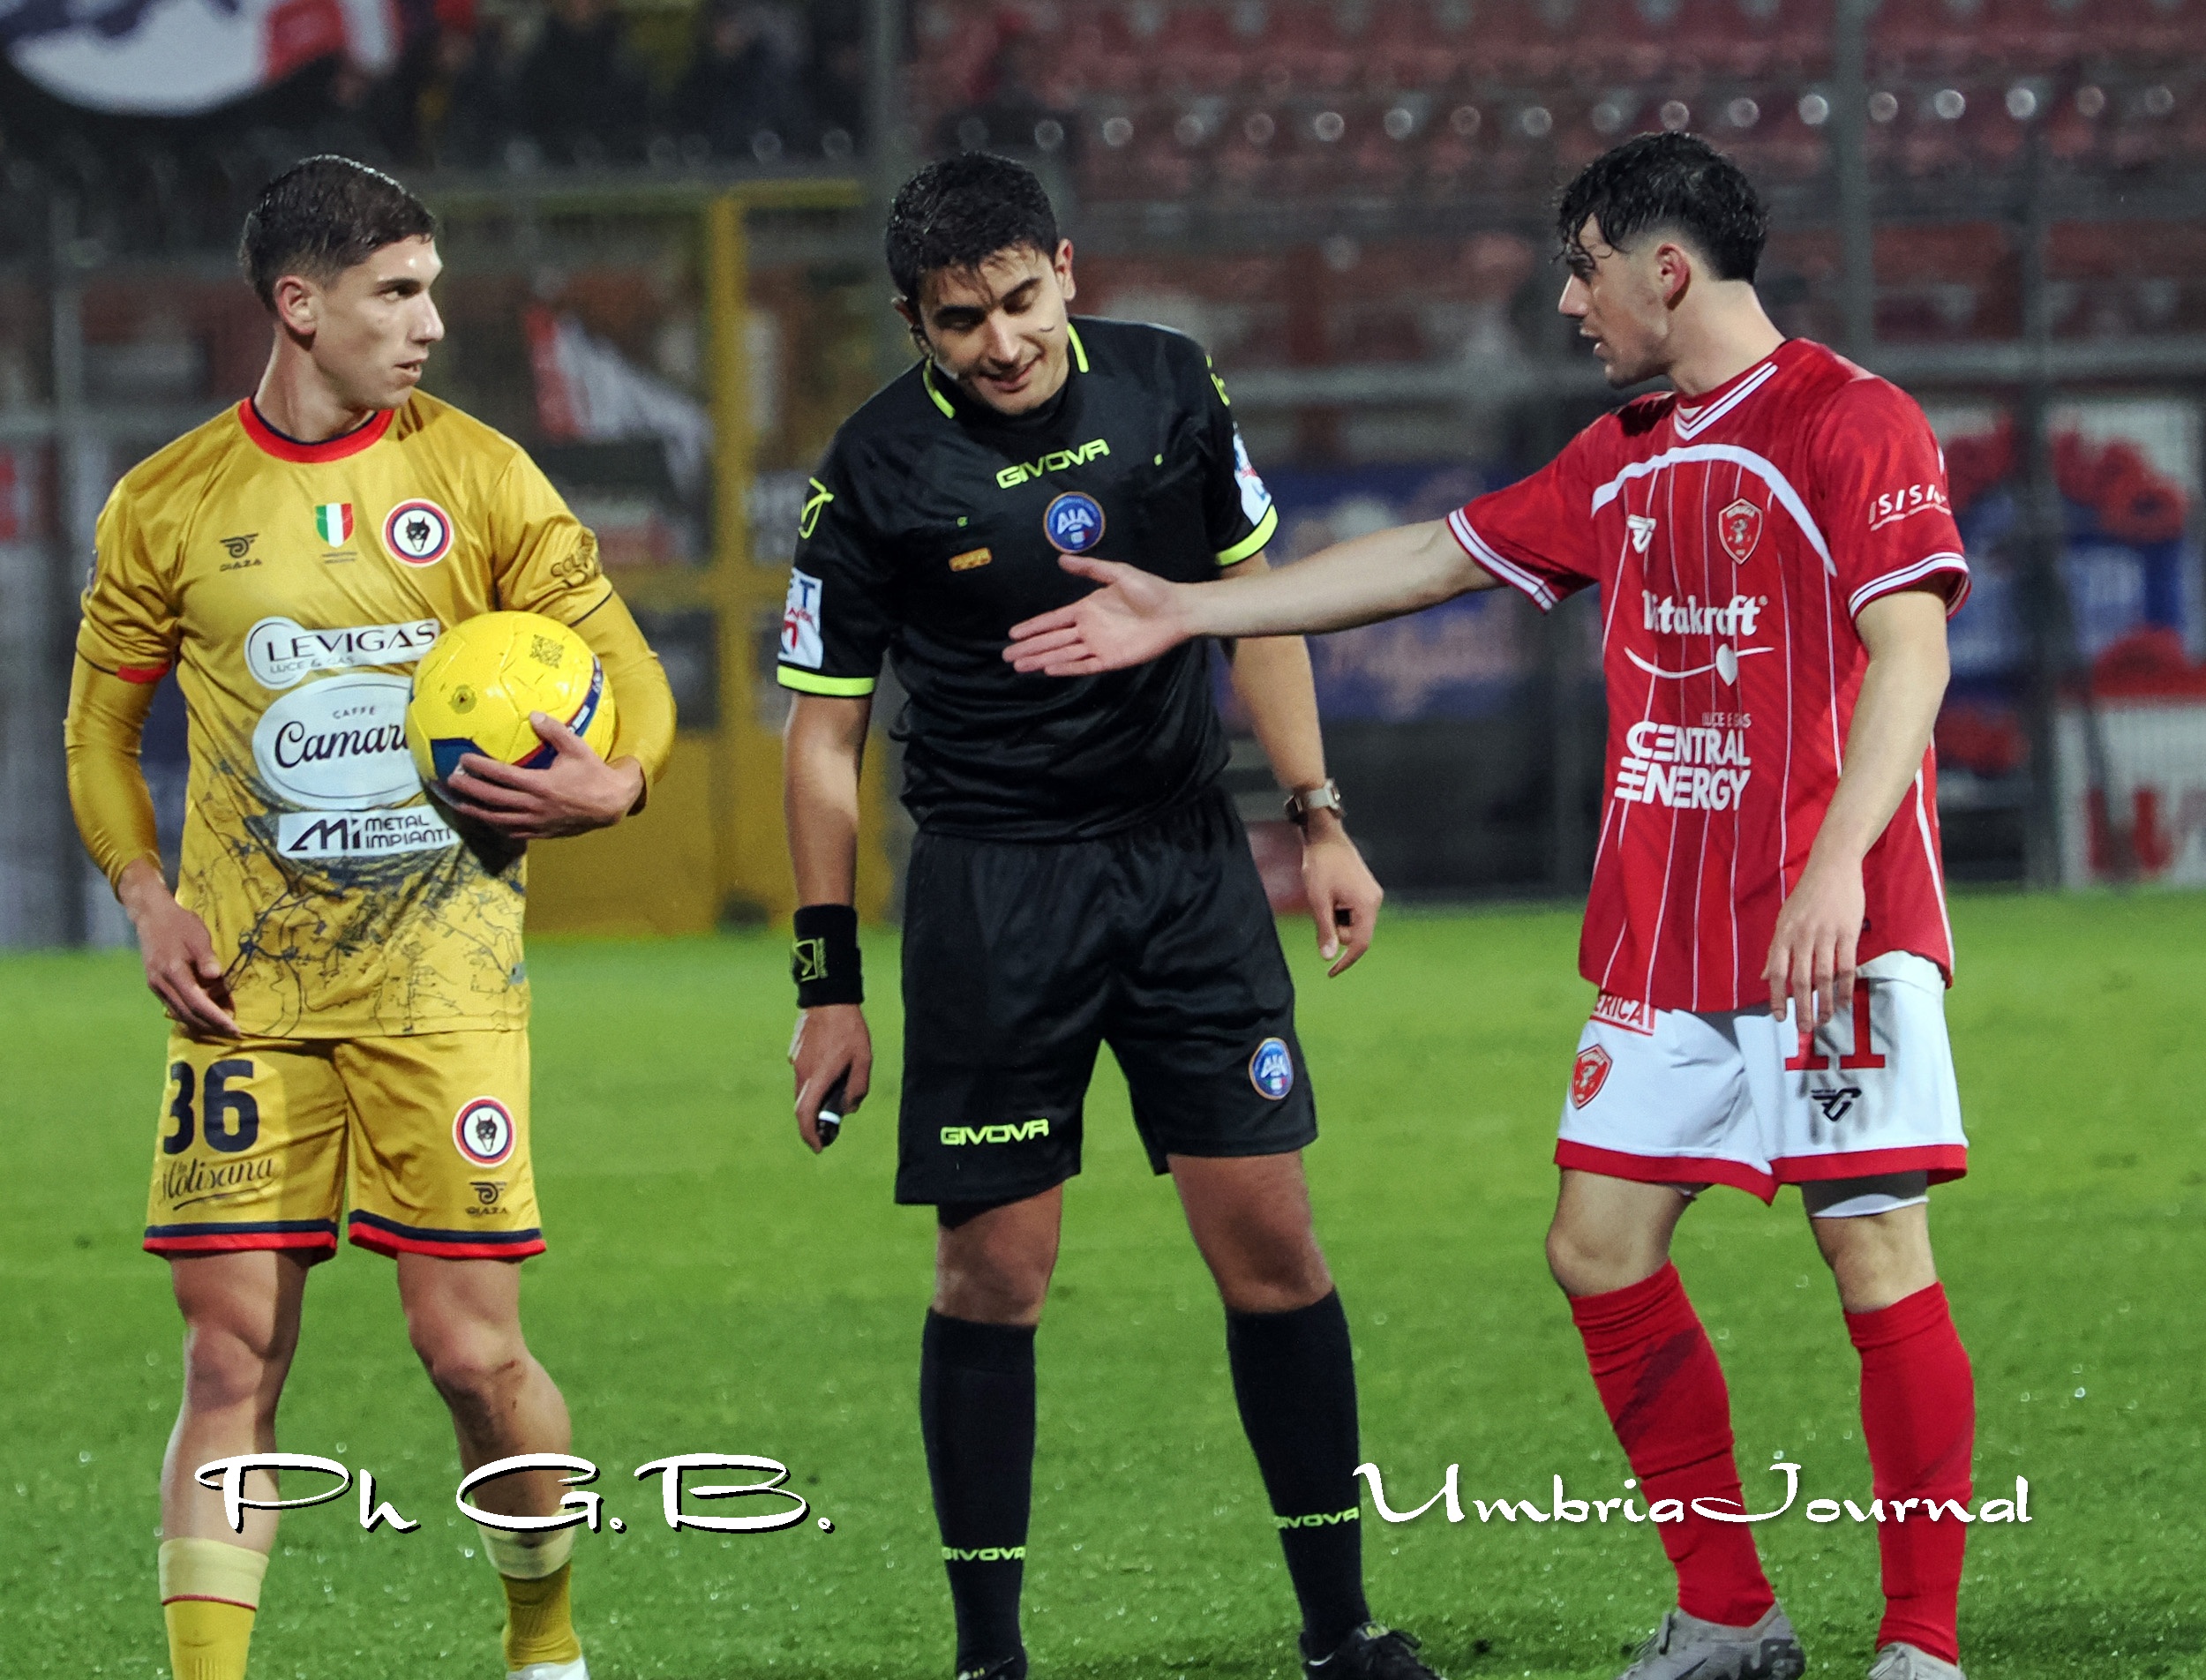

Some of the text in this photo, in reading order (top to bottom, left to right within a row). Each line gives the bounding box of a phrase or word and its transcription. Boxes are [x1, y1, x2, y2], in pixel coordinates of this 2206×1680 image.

[995, 438, 1111, 489] GIVOVA
[266, 622, 435, 662] LEVIGAS
[274, 721, 409, 769] Camar
[1626, 720, 1752, 767] CENTRAL
[1614, 756, 1752, 811] ENERGY
[365, 814, 430, 832] METAL
[366, 828, 451, 850] IMPIANTI
[163, 1059, 259, 1155] 36
[940, 1118, 1050, 1146] GIVOVA
